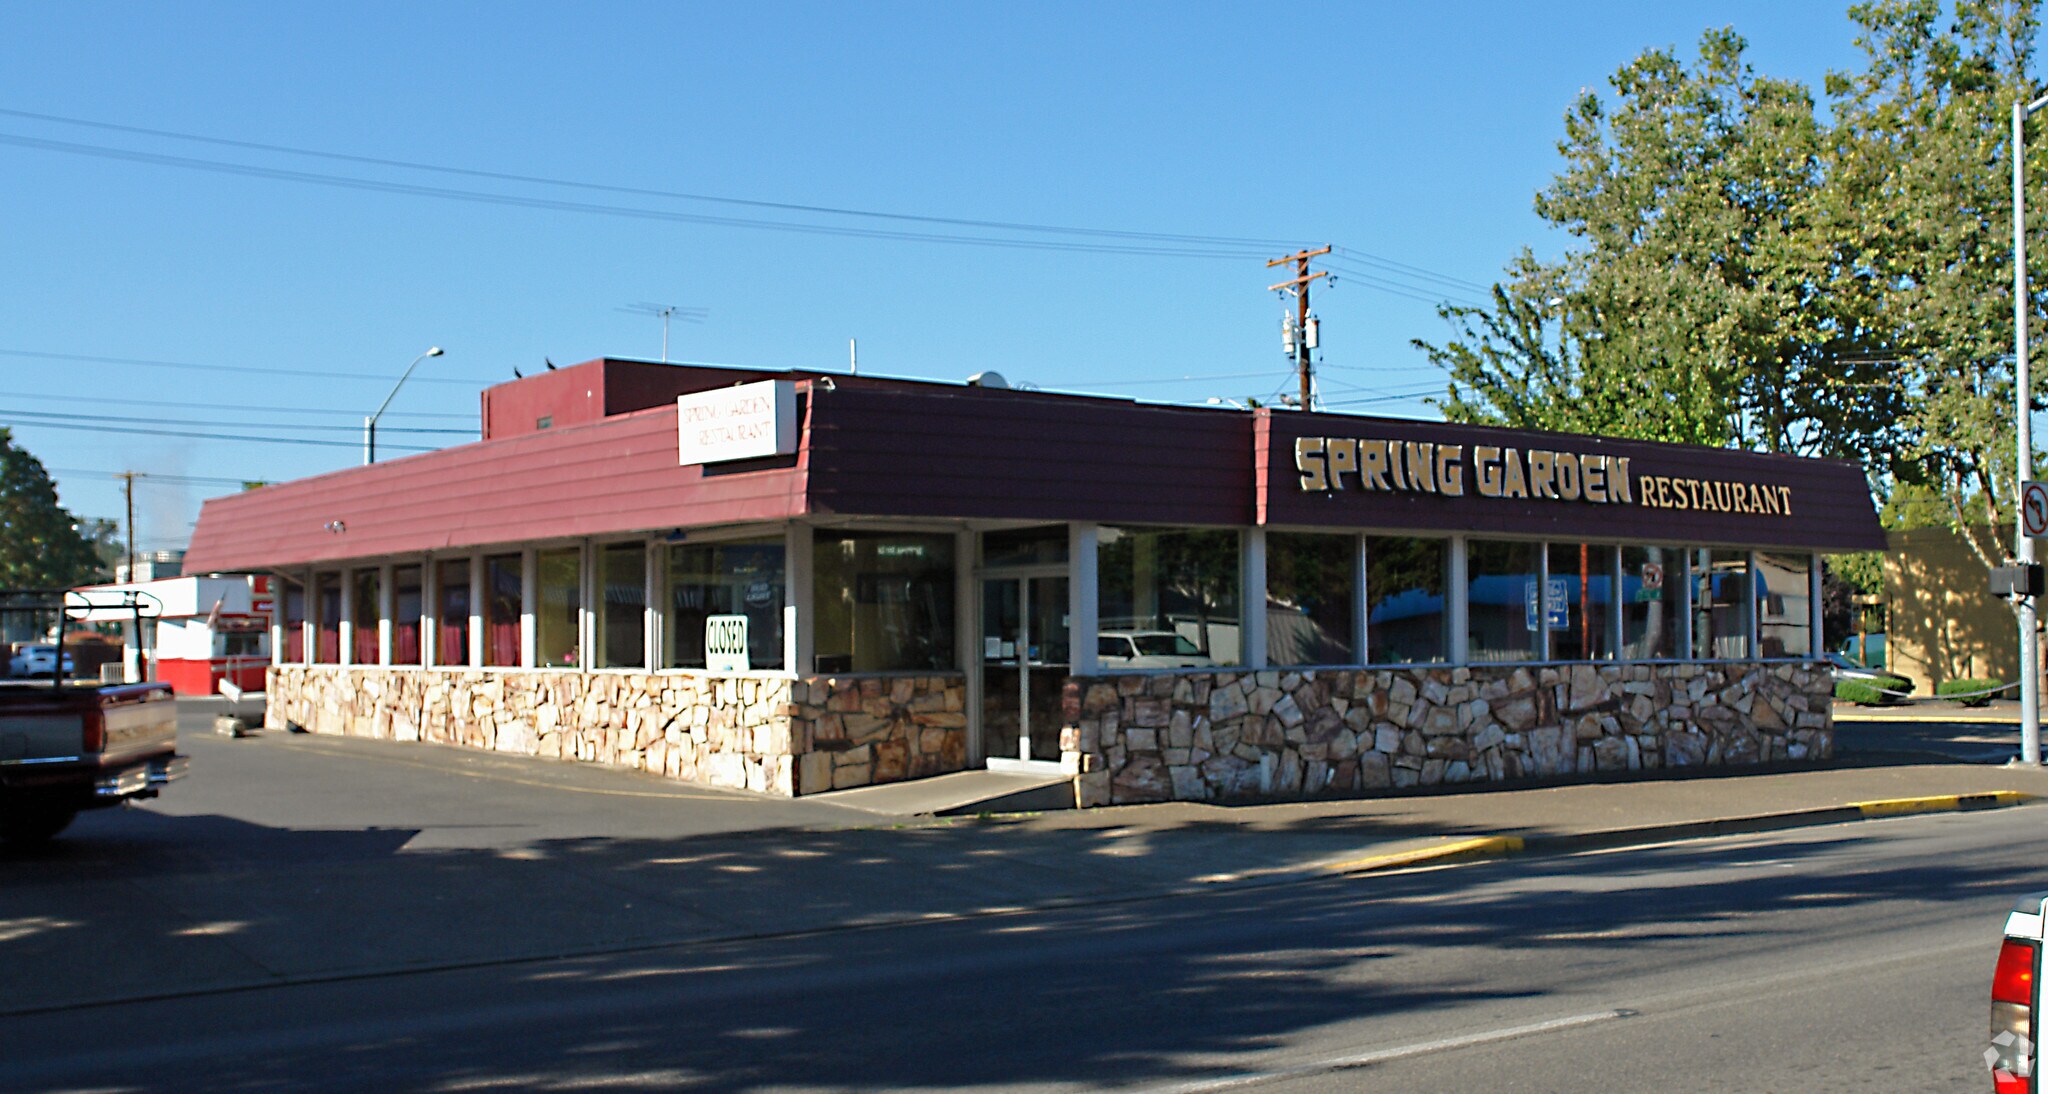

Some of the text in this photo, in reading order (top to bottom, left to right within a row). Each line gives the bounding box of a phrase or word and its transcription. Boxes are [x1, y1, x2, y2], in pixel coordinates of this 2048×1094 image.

[684, 396, 771, 424] SPRING GARDEN
[699, 421, 771, 446] RESTAURANT
[1295, 437, 1792, 516] SPRING GARDEN RESTAURANT
[708, 620, 744, 654] CLOSED
